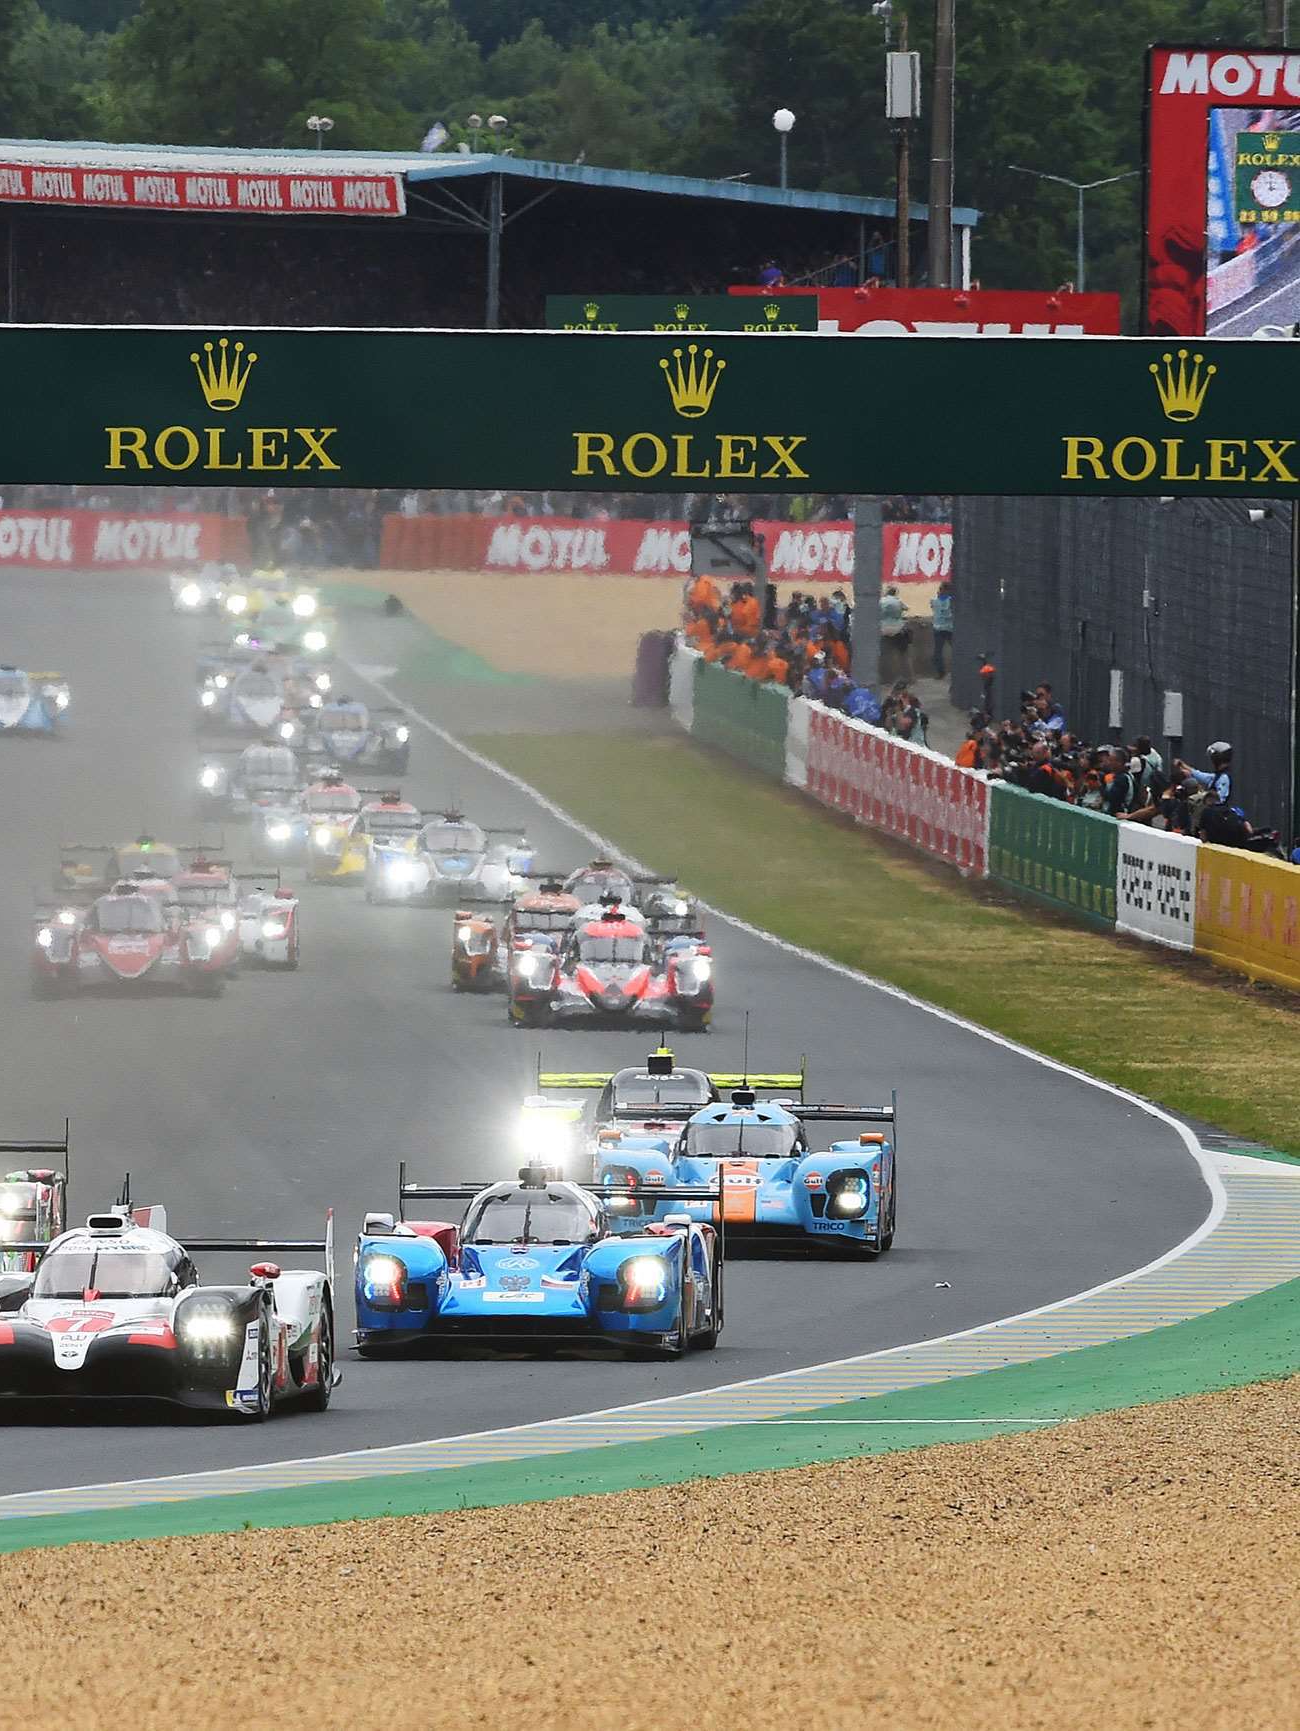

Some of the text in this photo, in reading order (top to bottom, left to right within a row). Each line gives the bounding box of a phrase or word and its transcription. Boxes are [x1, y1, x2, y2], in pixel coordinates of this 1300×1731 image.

[31, 169, 76, 199] MOTUL
[83, 173, 128, 202] MOTUL
[186, 177, 231, 206] MOTUL
[237, 180, 282, 208] MOTUL
[290, 181, 336, 210] MOTUL
[343, 181, 388, 210] MOTUL
[104, 427, 341, 470] ROLEX
[571, 433, 809, 478] ROLEX
[1061, 437, 1299, 481] ROLEX
[93, 520, 200, 561] MOTUL
[486, 525, 610, 571] MOTUL
[772, 529, 856, 575] MOTU
[892, 530, 954, 575] MOT
[803, 1177, 824, 1186] Gulf
[813, 1223, 845, 1231] TRICO
